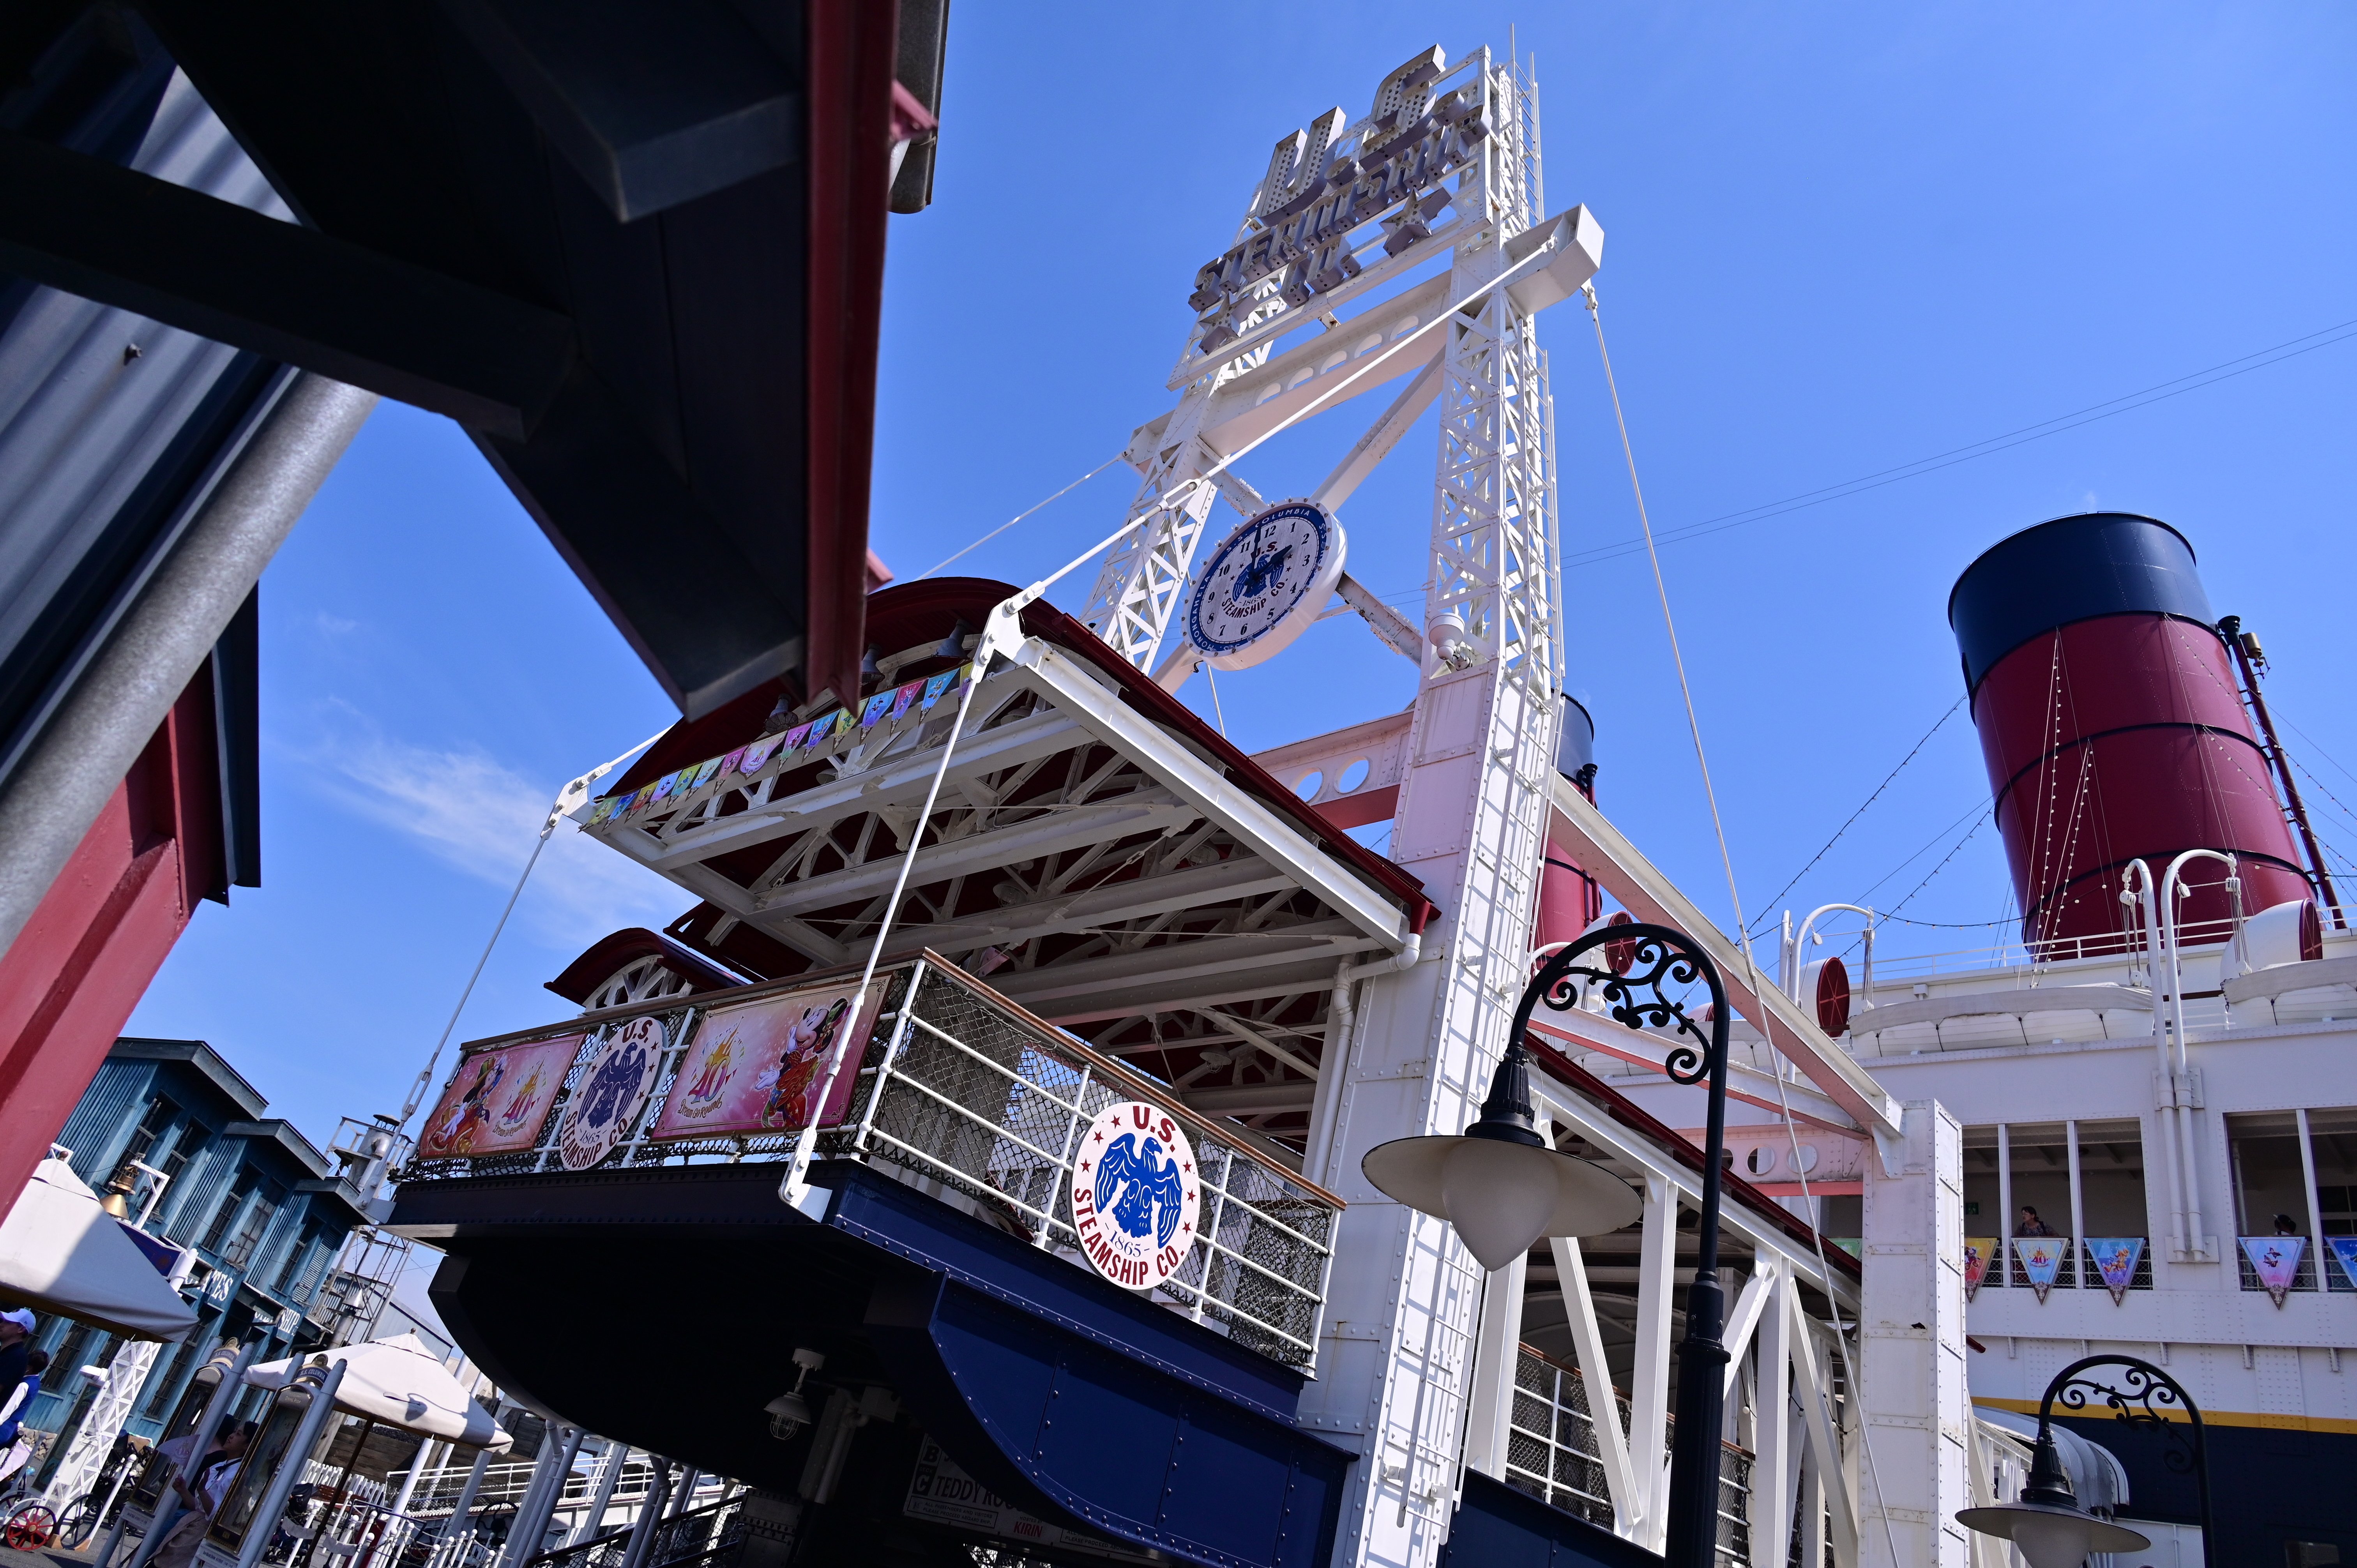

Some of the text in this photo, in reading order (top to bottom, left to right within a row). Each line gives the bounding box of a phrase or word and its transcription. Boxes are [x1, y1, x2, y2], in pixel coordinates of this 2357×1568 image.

[1256, 42, 1467, 227] U.S.
[1188, 104, 1493, 312] STEAMSHIP
[1281, 235, 1361, 309] CO.
[1255, 509, 1310, 528] COLUMBIA
[1264, 525, 1276, 539] 12
[1290, 522, 1296, 533] 1
[1240, 540, 1251, 553] 11
[1301, 533, 1309, 545] 2
[1251, 541, 1277, 558] U.S.
[1302, 555, 1310, 566] 3
[1218, 564, 1230, 577] 10
[1290, 582, 1297, 594] 4
[1208, 592, 1215, 603] 9
[1222, 578, 1288, 618] STEAMSHIP CO.
[1192, 576, 1214, 651] MONONGAHELA
[1207, 613, 1215, 624] 8
[1267, 607, 1275, 620] 5
[1219, 624, 1226, 637] 7
[1240, 623, 1248, 635] 6
[622, 1019, 653, 1043] U.S.
[687, 1054, 731, 1104] 40
[502, 1084, 536, 1125] 40
[1133, 1105, 1176, 1153] U.S.
[562, 1111, 634, 1168] STEAMSHIP CO.
[1074, 1188, 1185, 1285] STEAMSHIP CO.
[2031, 1254, 2046, 1264] 40
[308, 1369, 326, 1381] COLUMBIA
[923, 1445, 940, 1462] B
[916, 1474, 930, 1492] C
[935, 1476, 981, 1503] TEDDY
[1013, 1522, 1043, 1538] KIRIN
[1085, 1539, 1108, 1547] PROCEED
